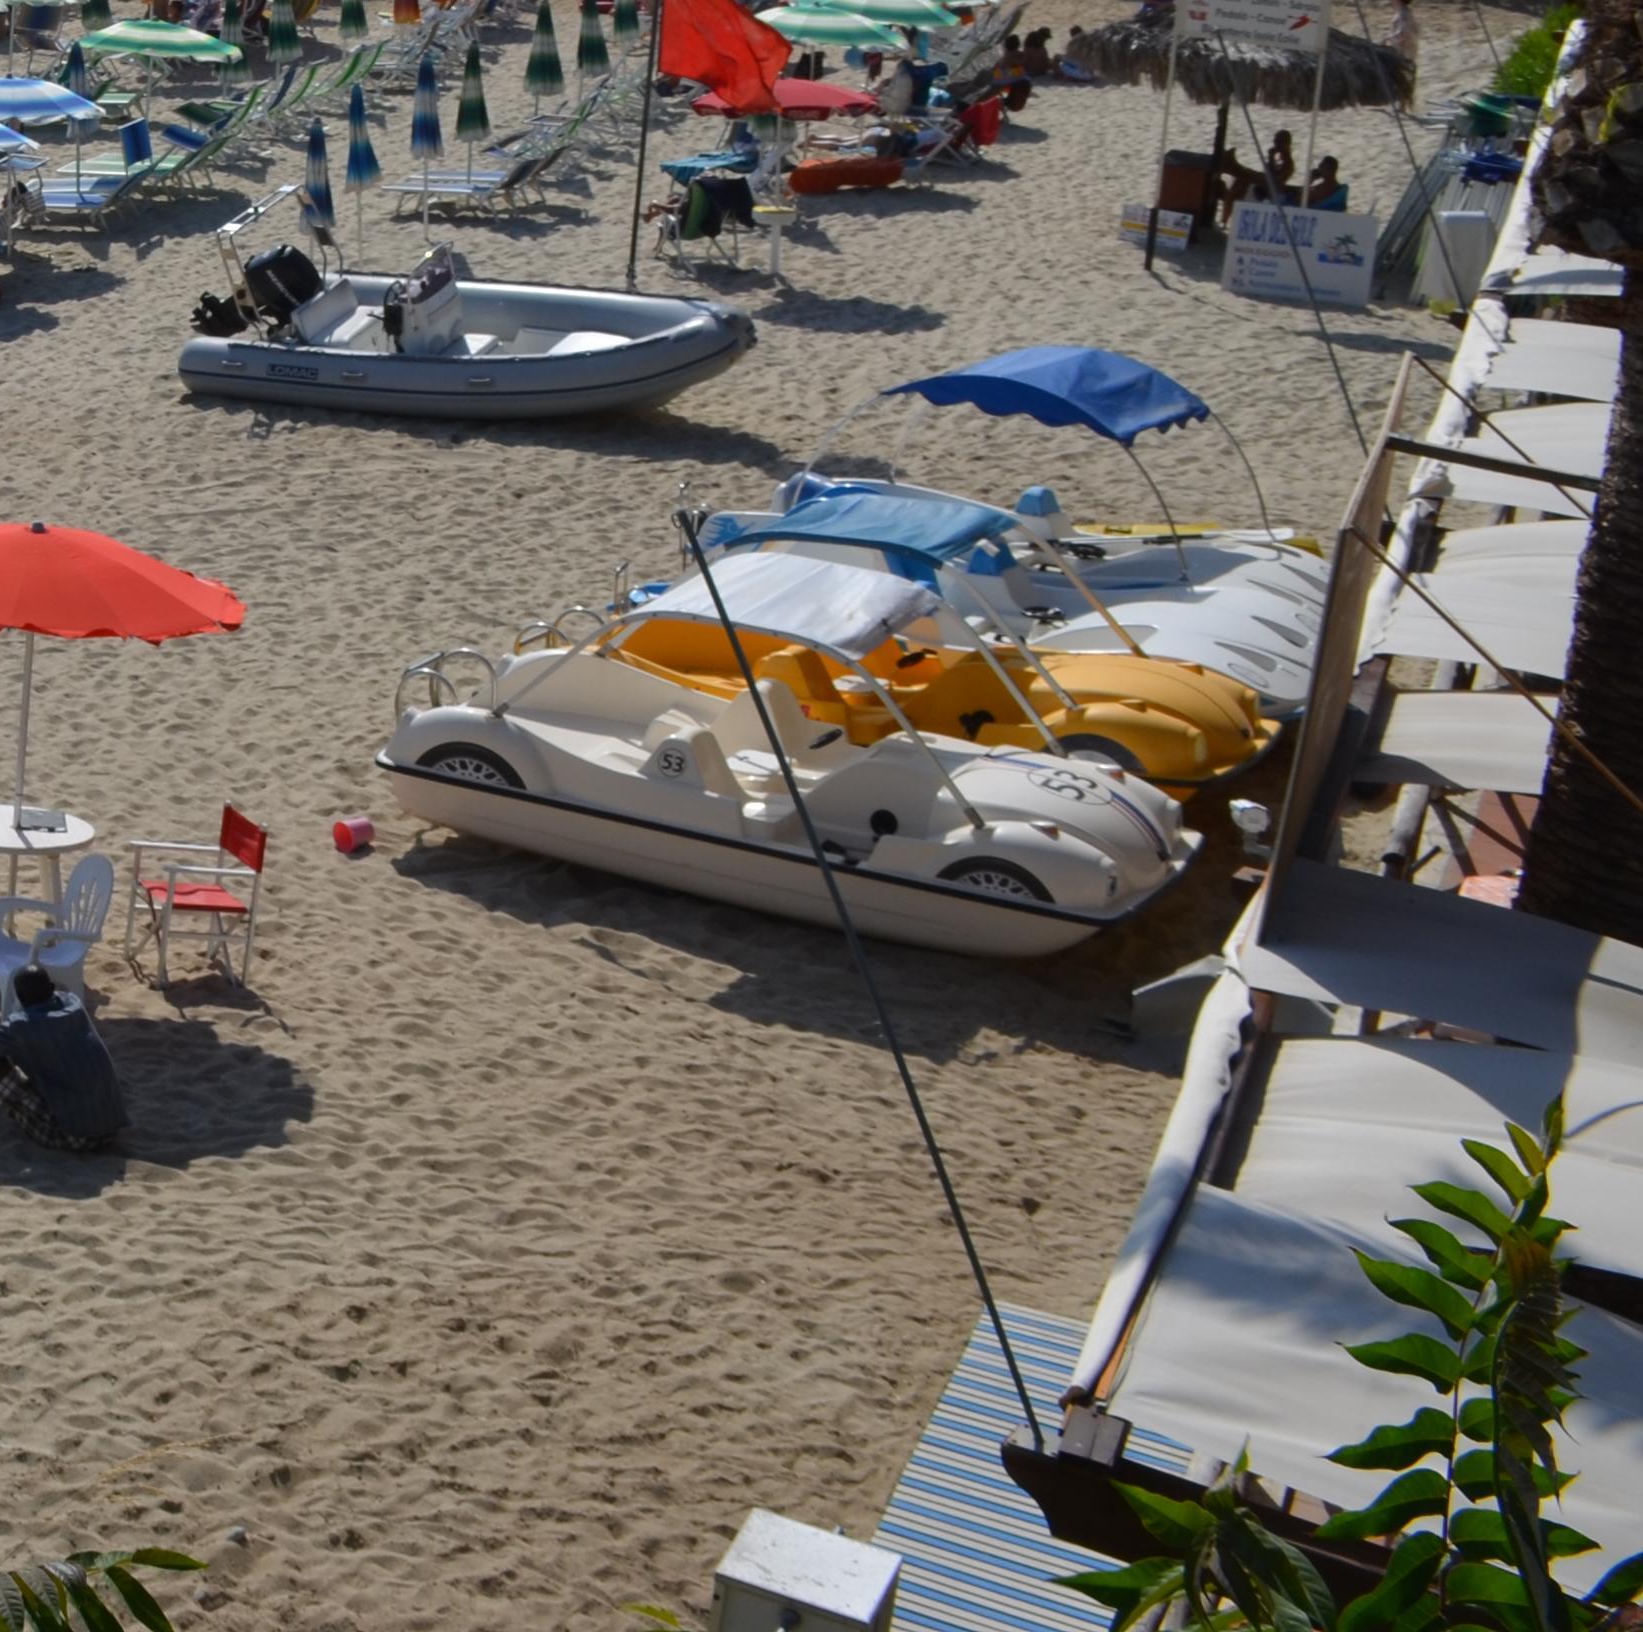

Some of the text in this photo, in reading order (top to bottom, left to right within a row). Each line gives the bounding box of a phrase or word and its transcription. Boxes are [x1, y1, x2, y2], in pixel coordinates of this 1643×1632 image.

[268, 365, 318, 380] LOMAC
[661, 754, 684, 773] 53
[1041, 770, 1097, 800] 53
